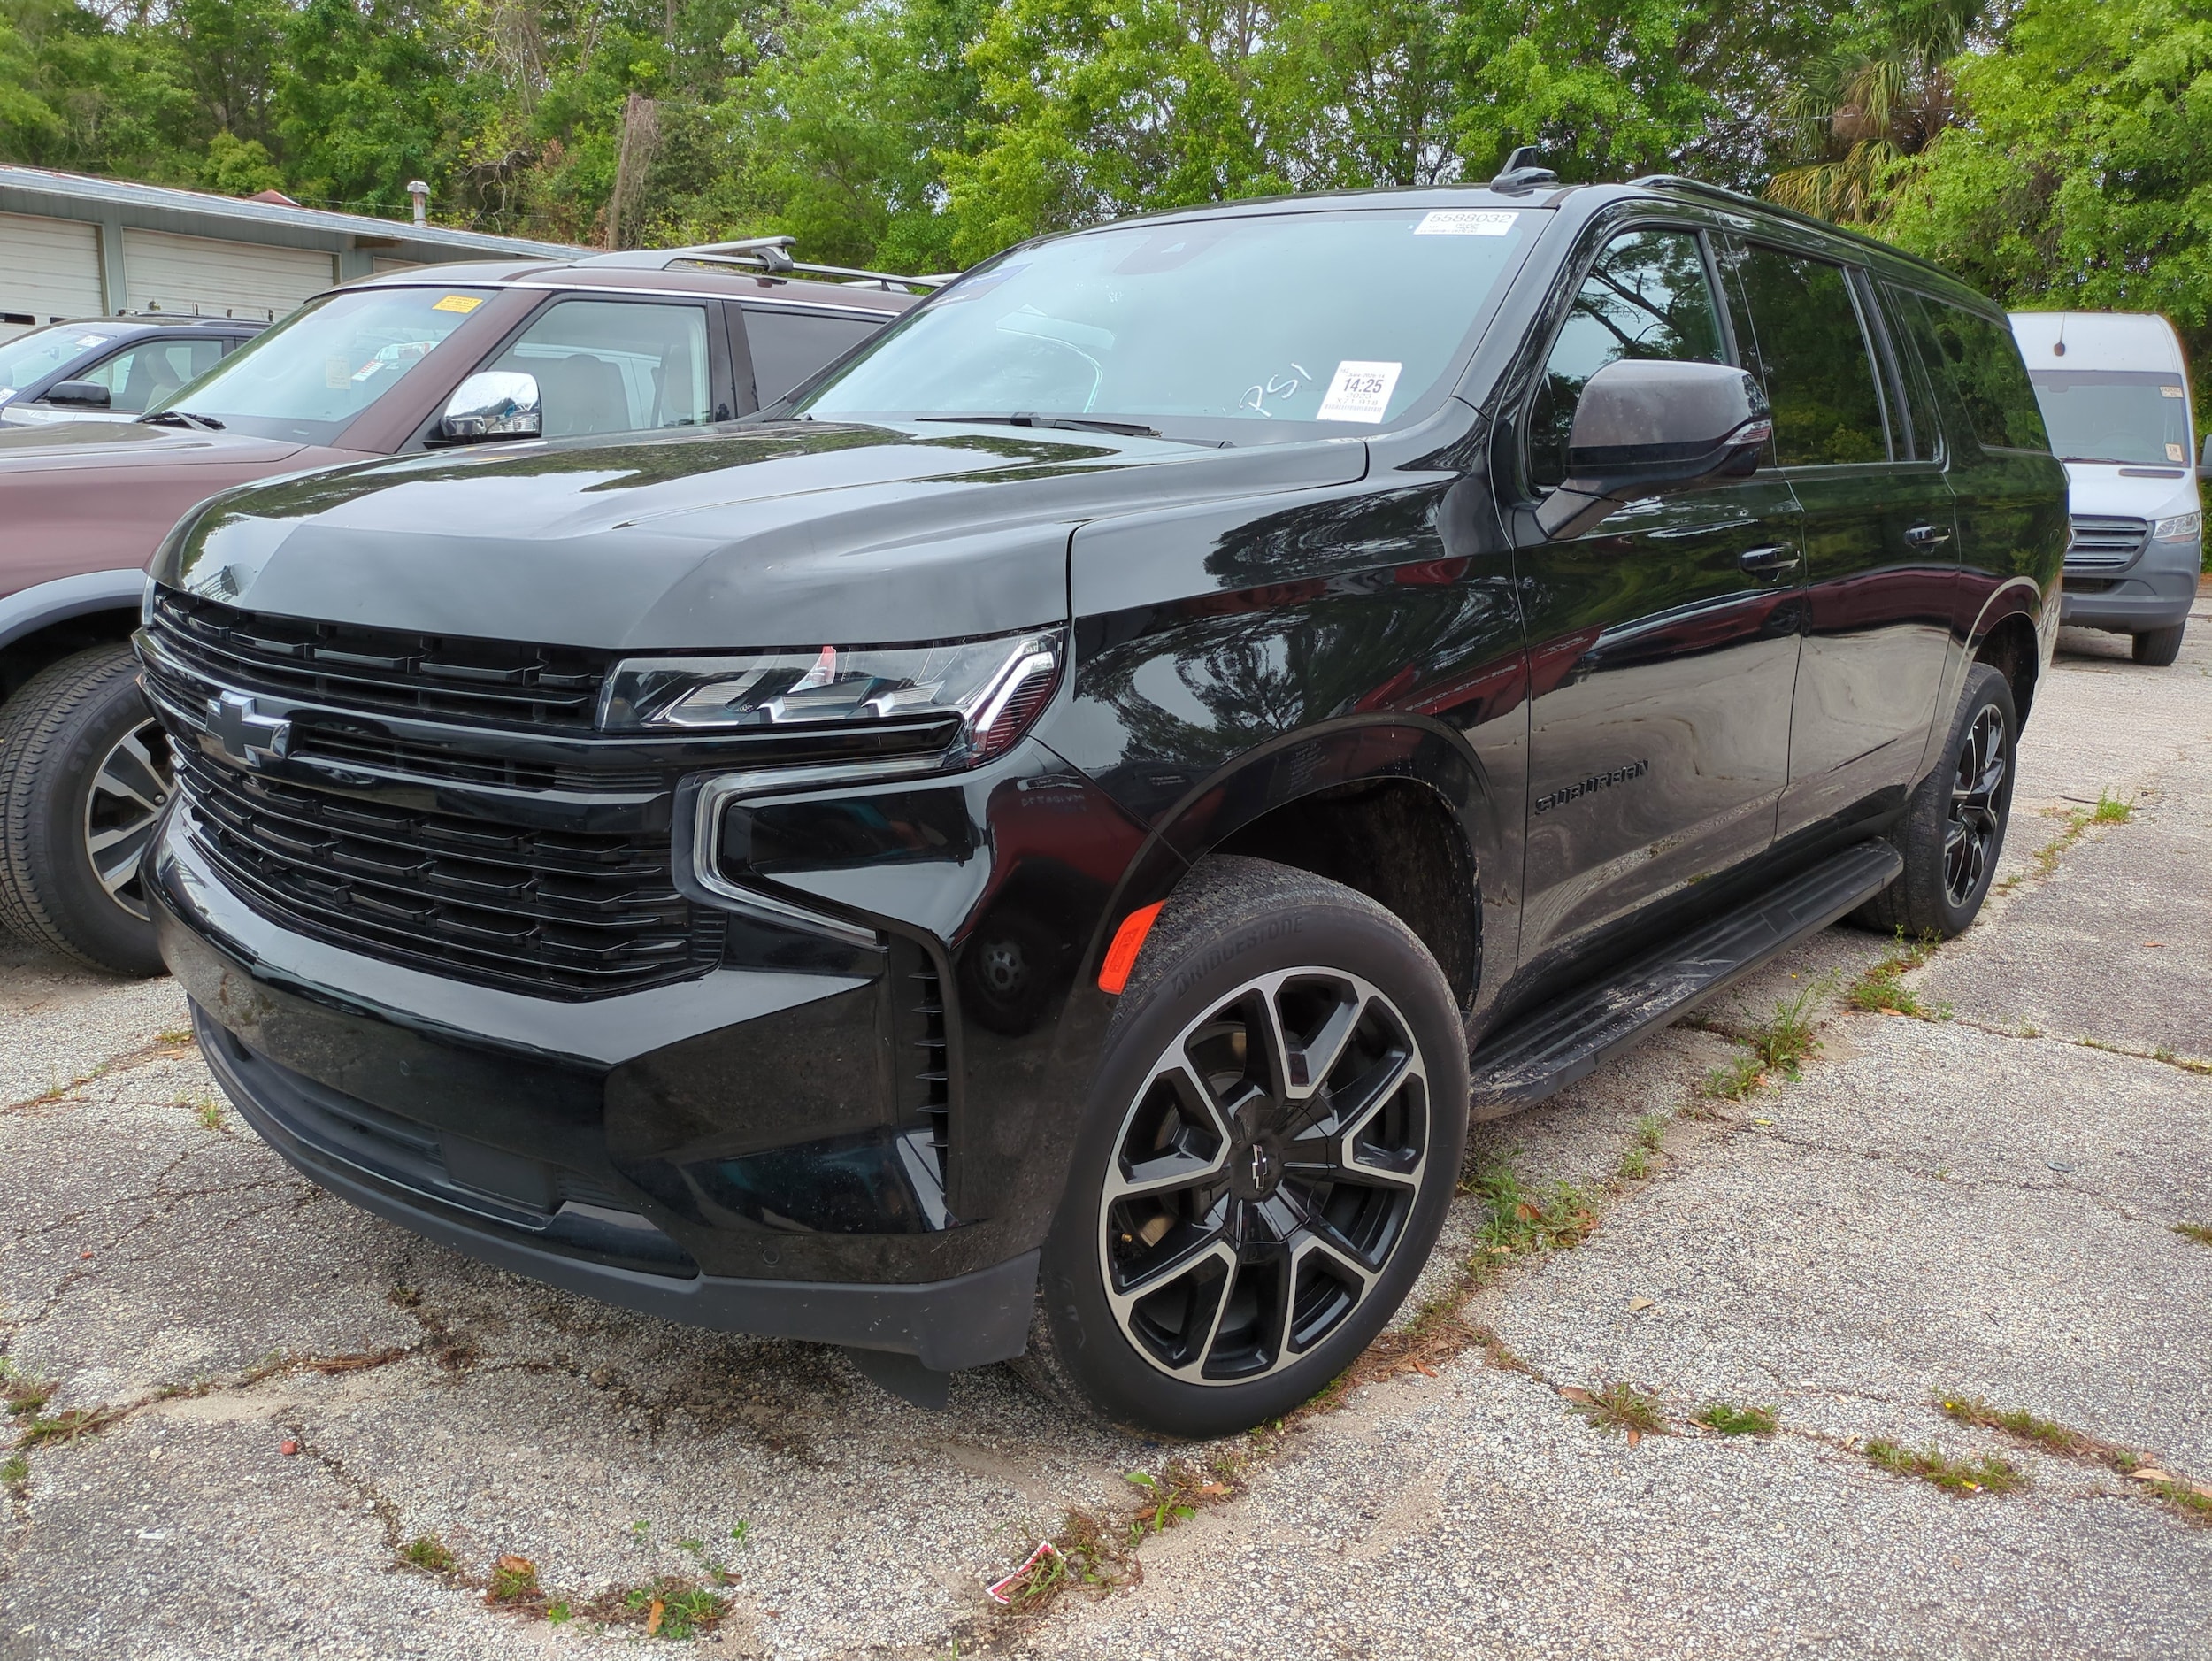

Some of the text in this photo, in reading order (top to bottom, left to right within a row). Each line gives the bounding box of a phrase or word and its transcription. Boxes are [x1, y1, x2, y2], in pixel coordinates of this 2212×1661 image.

[1430, 213, 1512, 223] 5588032
[1344, 378, 1384, 393] 14:25
[1535, 759, 1648, 815] SUBURBAN
[1171, 917, 1303, 998] BRIDGESTONE
